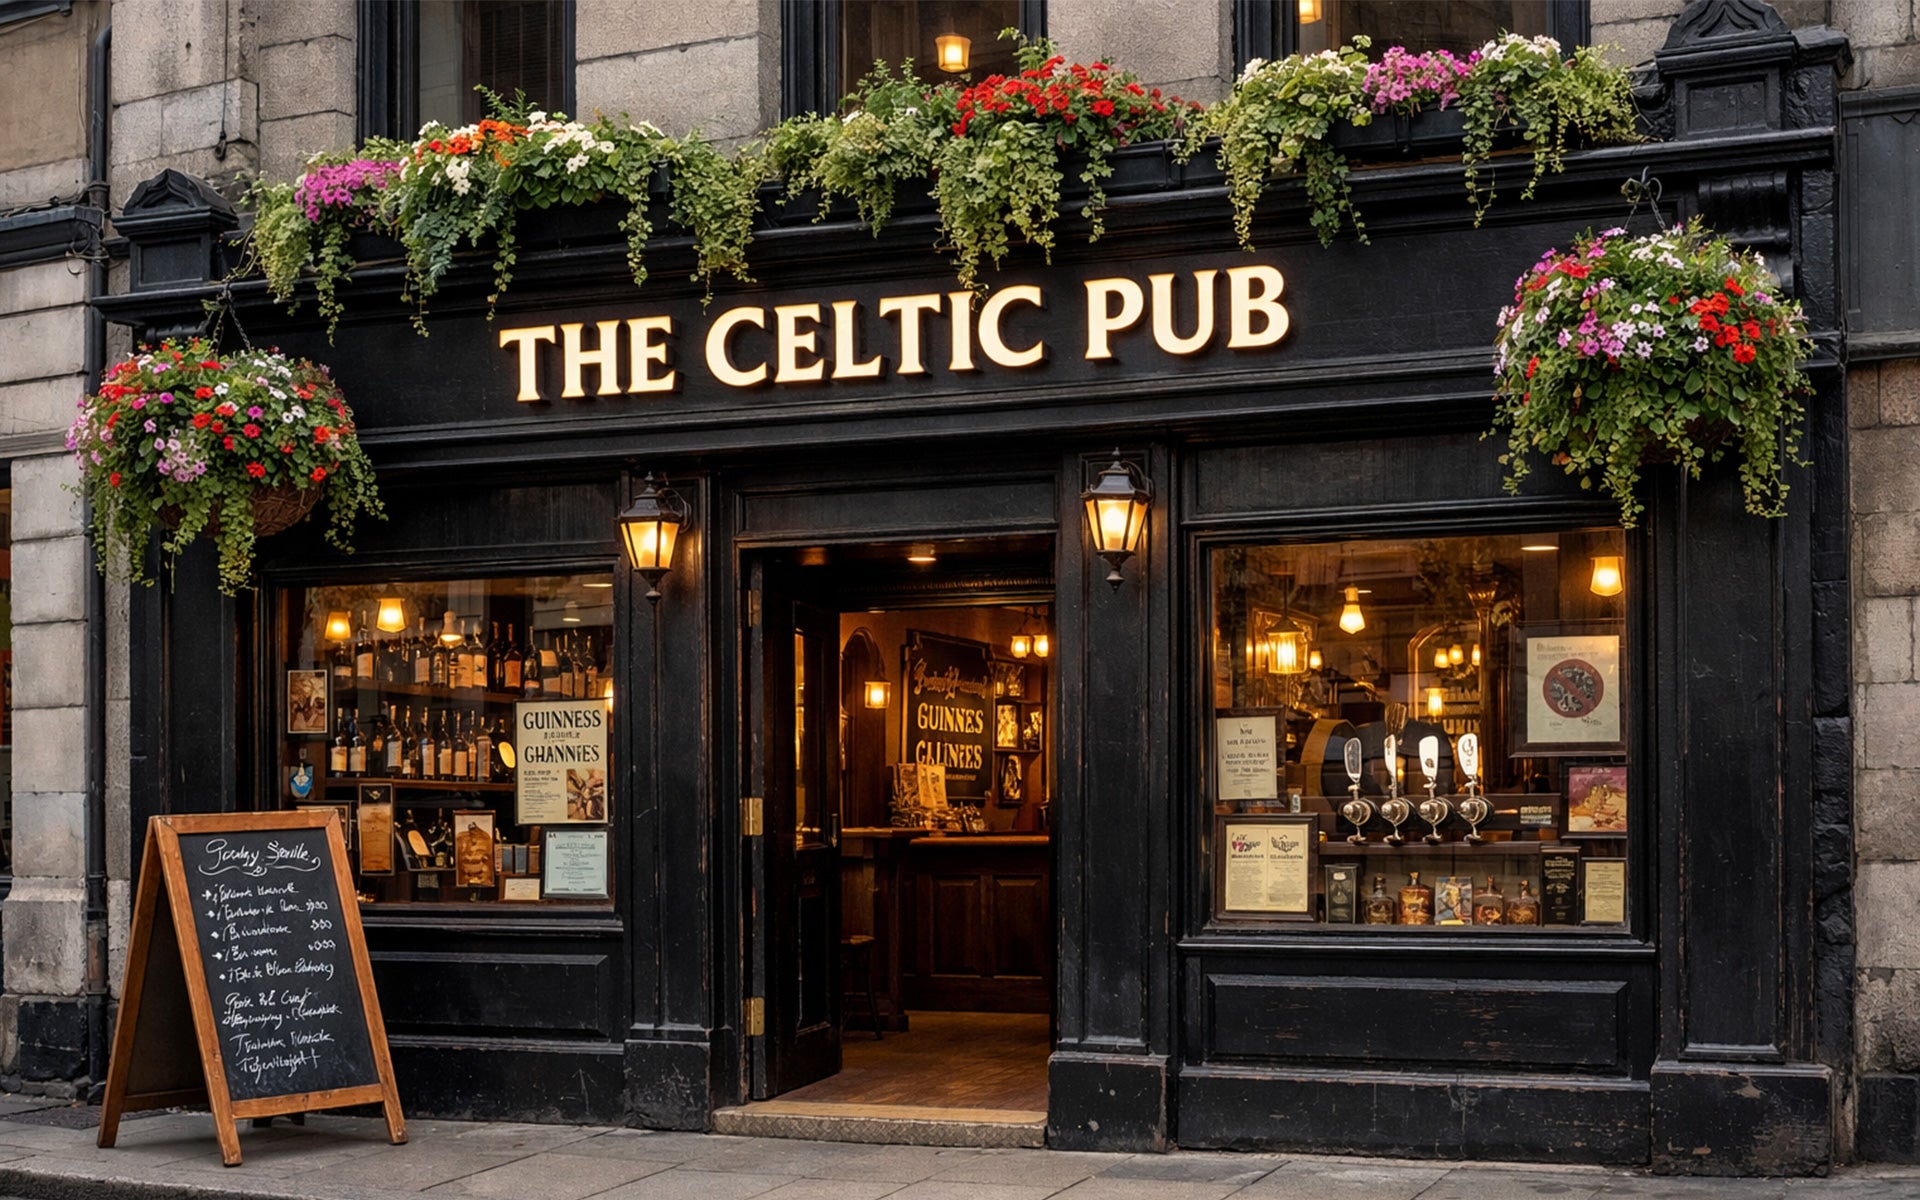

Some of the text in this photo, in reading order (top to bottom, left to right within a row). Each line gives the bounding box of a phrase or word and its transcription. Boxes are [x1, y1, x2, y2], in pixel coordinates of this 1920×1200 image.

[499, 264, 1291, 402] THE CELTIC PUB
[523, 709, 602, 730] GUINNESS
